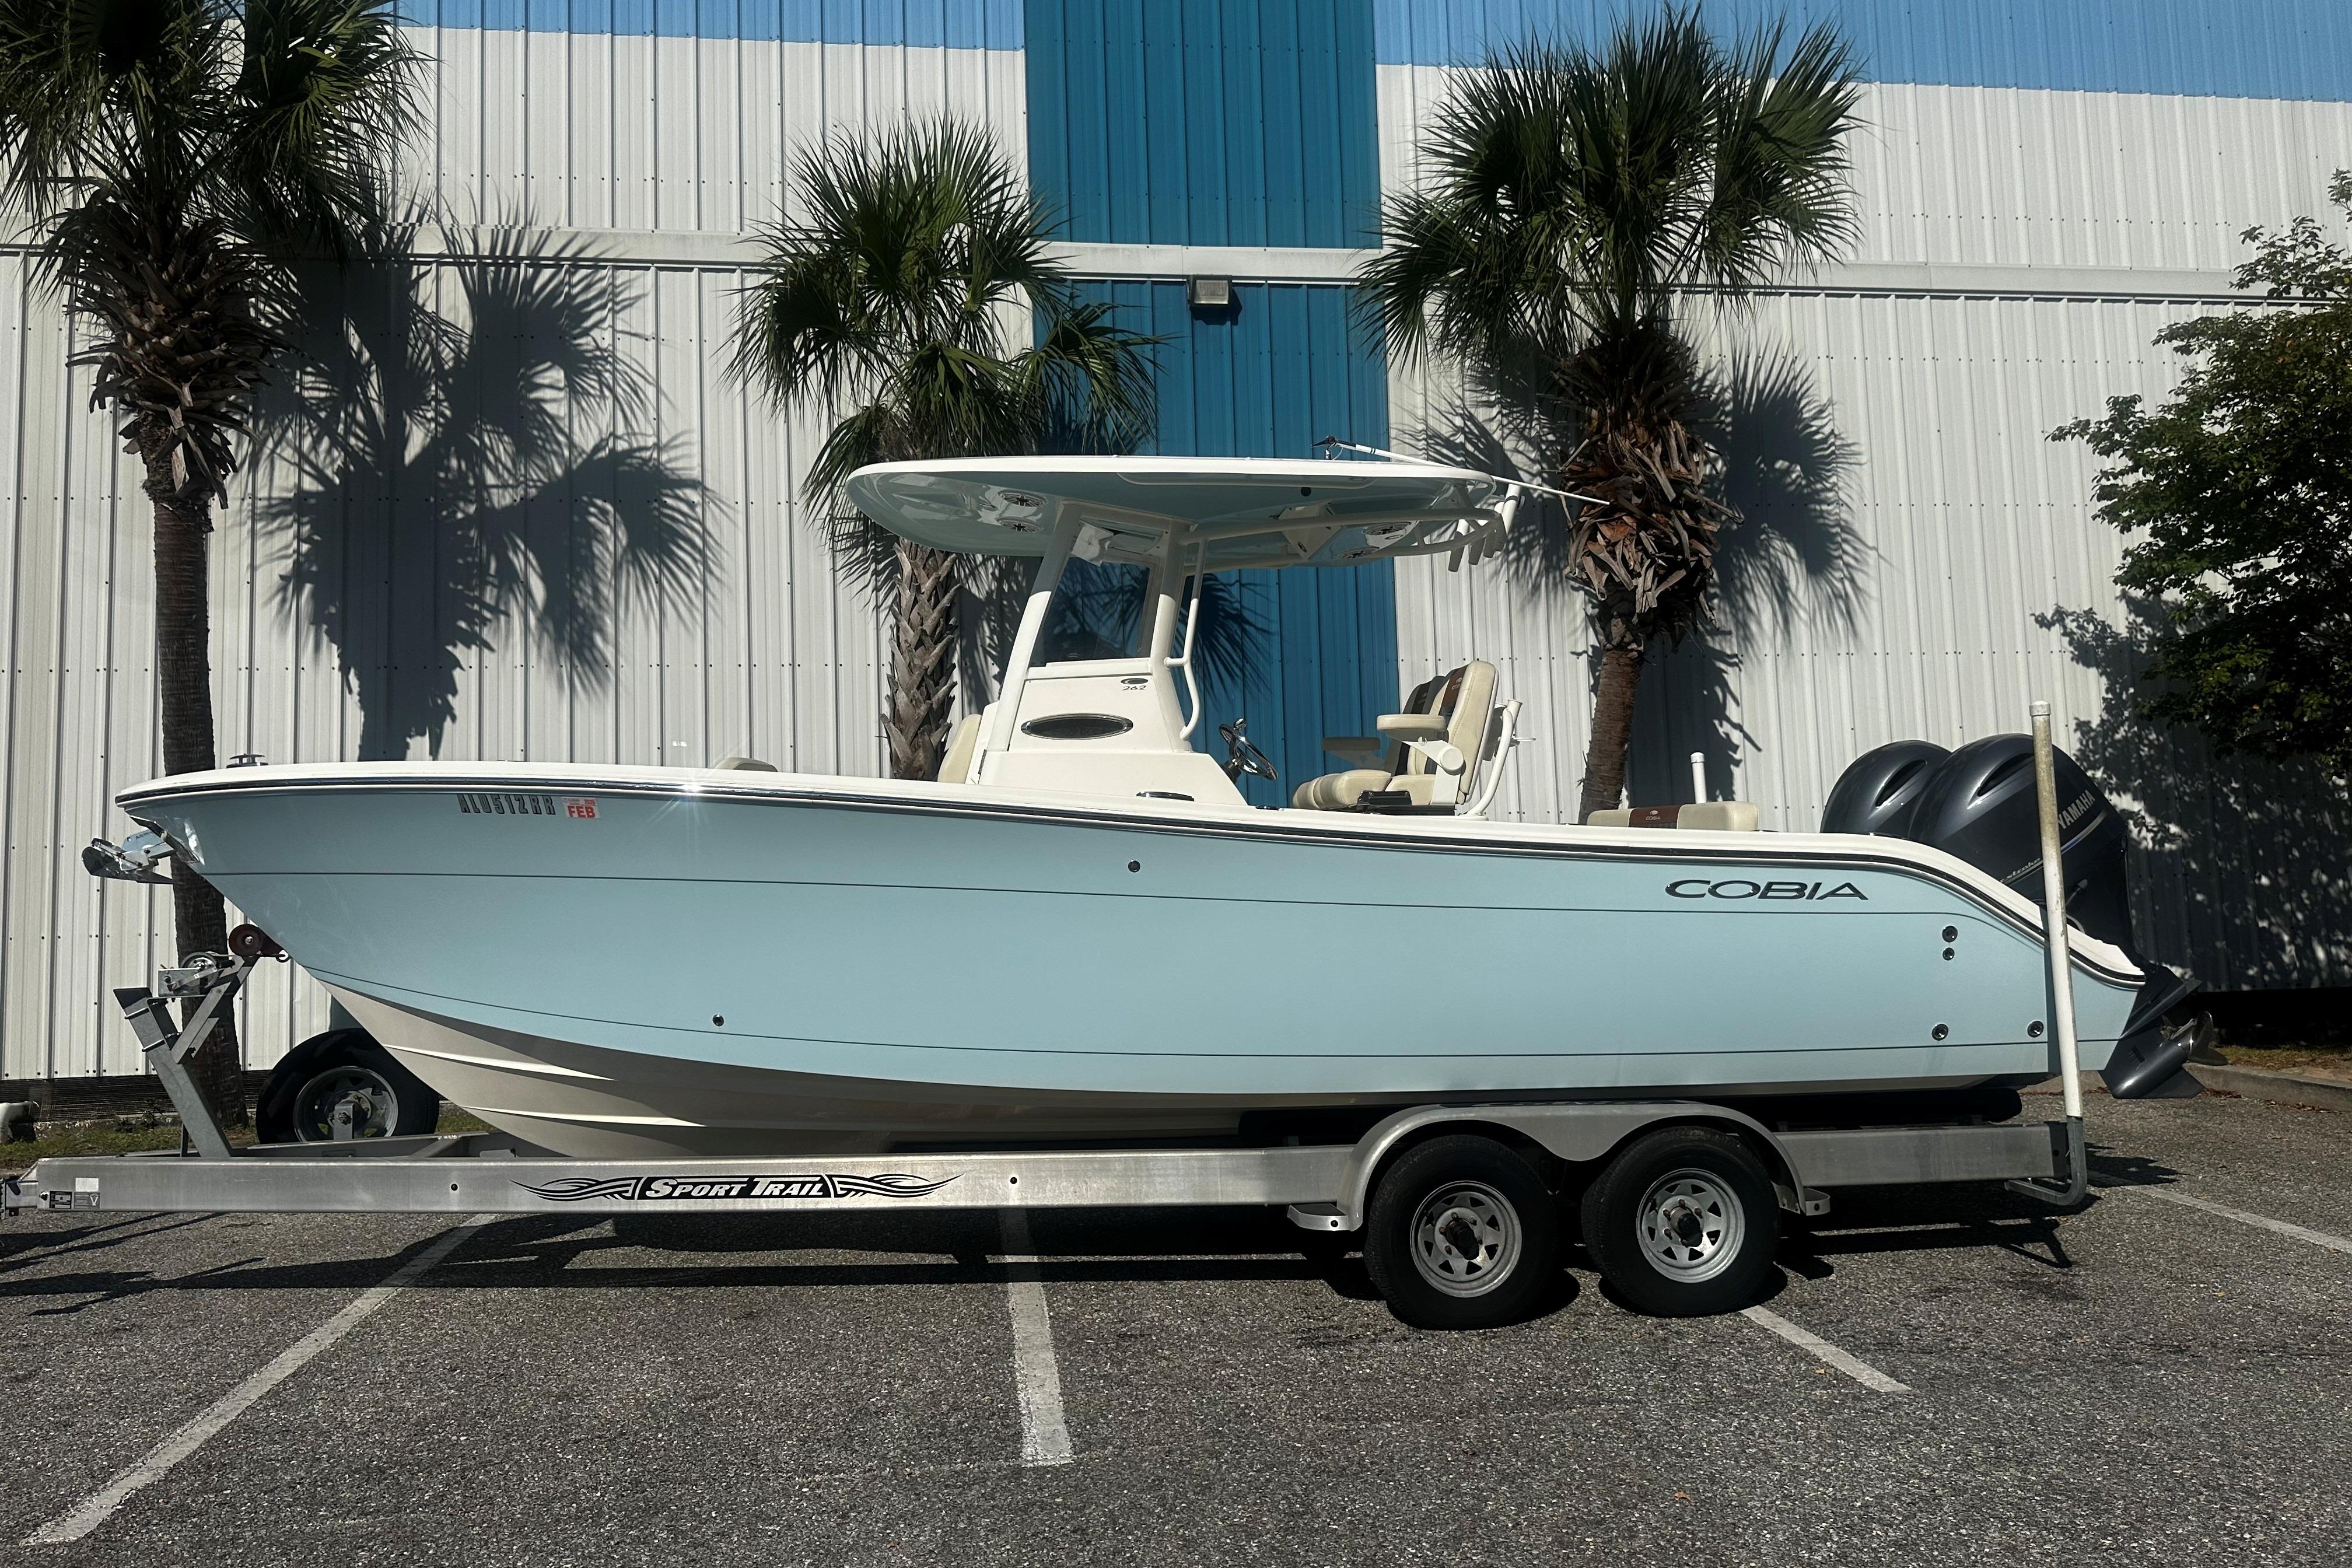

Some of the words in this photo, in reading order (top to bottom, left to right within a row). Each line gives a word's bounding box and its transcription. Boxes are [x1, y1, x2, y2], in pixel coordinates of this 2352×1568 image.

[567, 805, 596, 818] FEB
[2057, 789, 2095, 830] YAMAHA
[1665, 880, 1868, 900] COBIA
